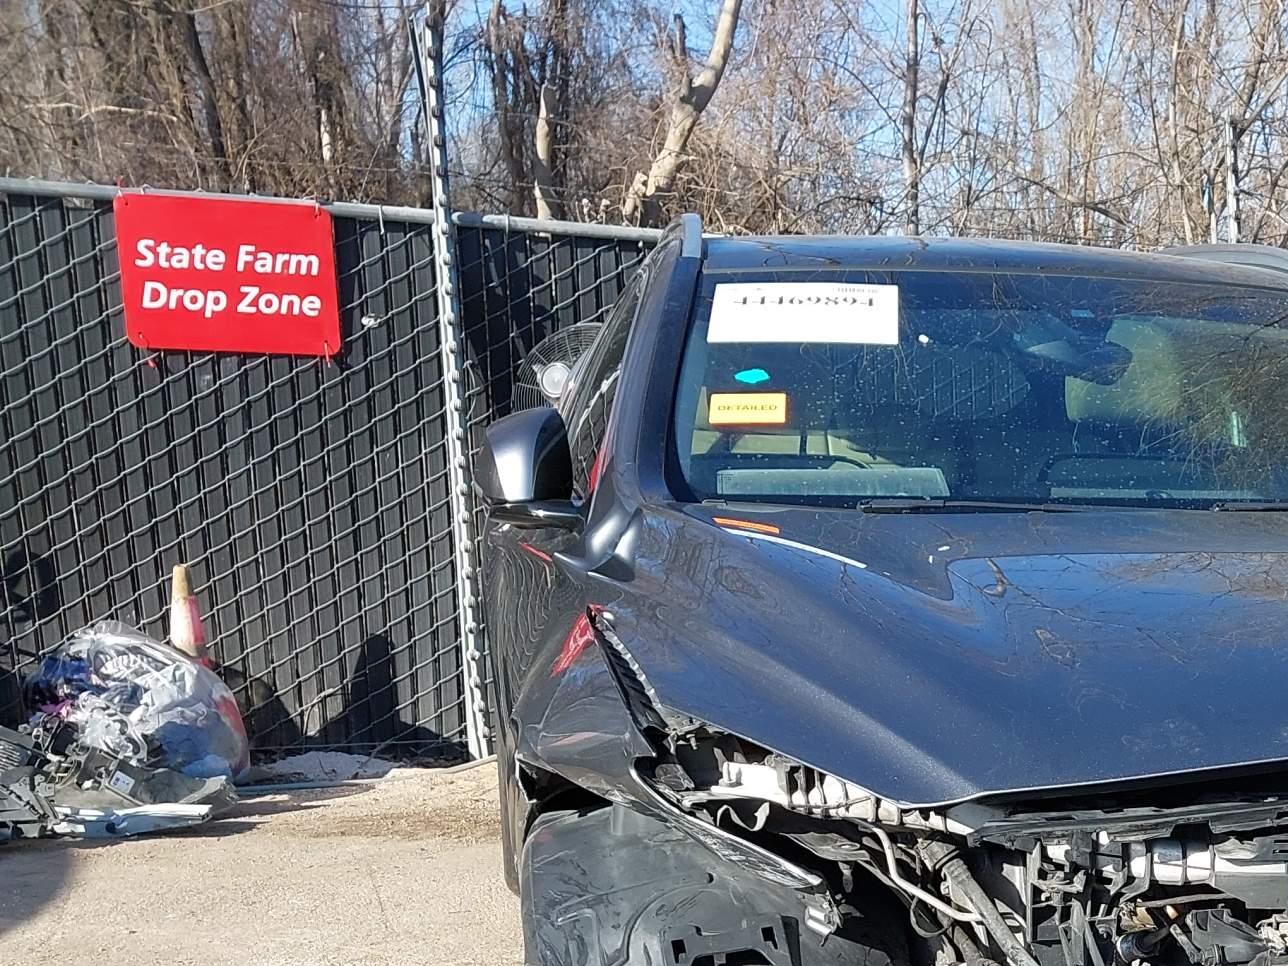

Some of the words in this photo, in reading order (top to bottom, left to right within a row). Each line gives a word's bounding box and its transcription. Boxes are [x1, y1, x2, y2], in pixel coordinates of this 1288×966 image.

[134, 238, 226, 271] State
[236, 244, 320, 277] Farm
[141, 280, 228, 319] Drop
[236, 285, 322, 317] Zone
